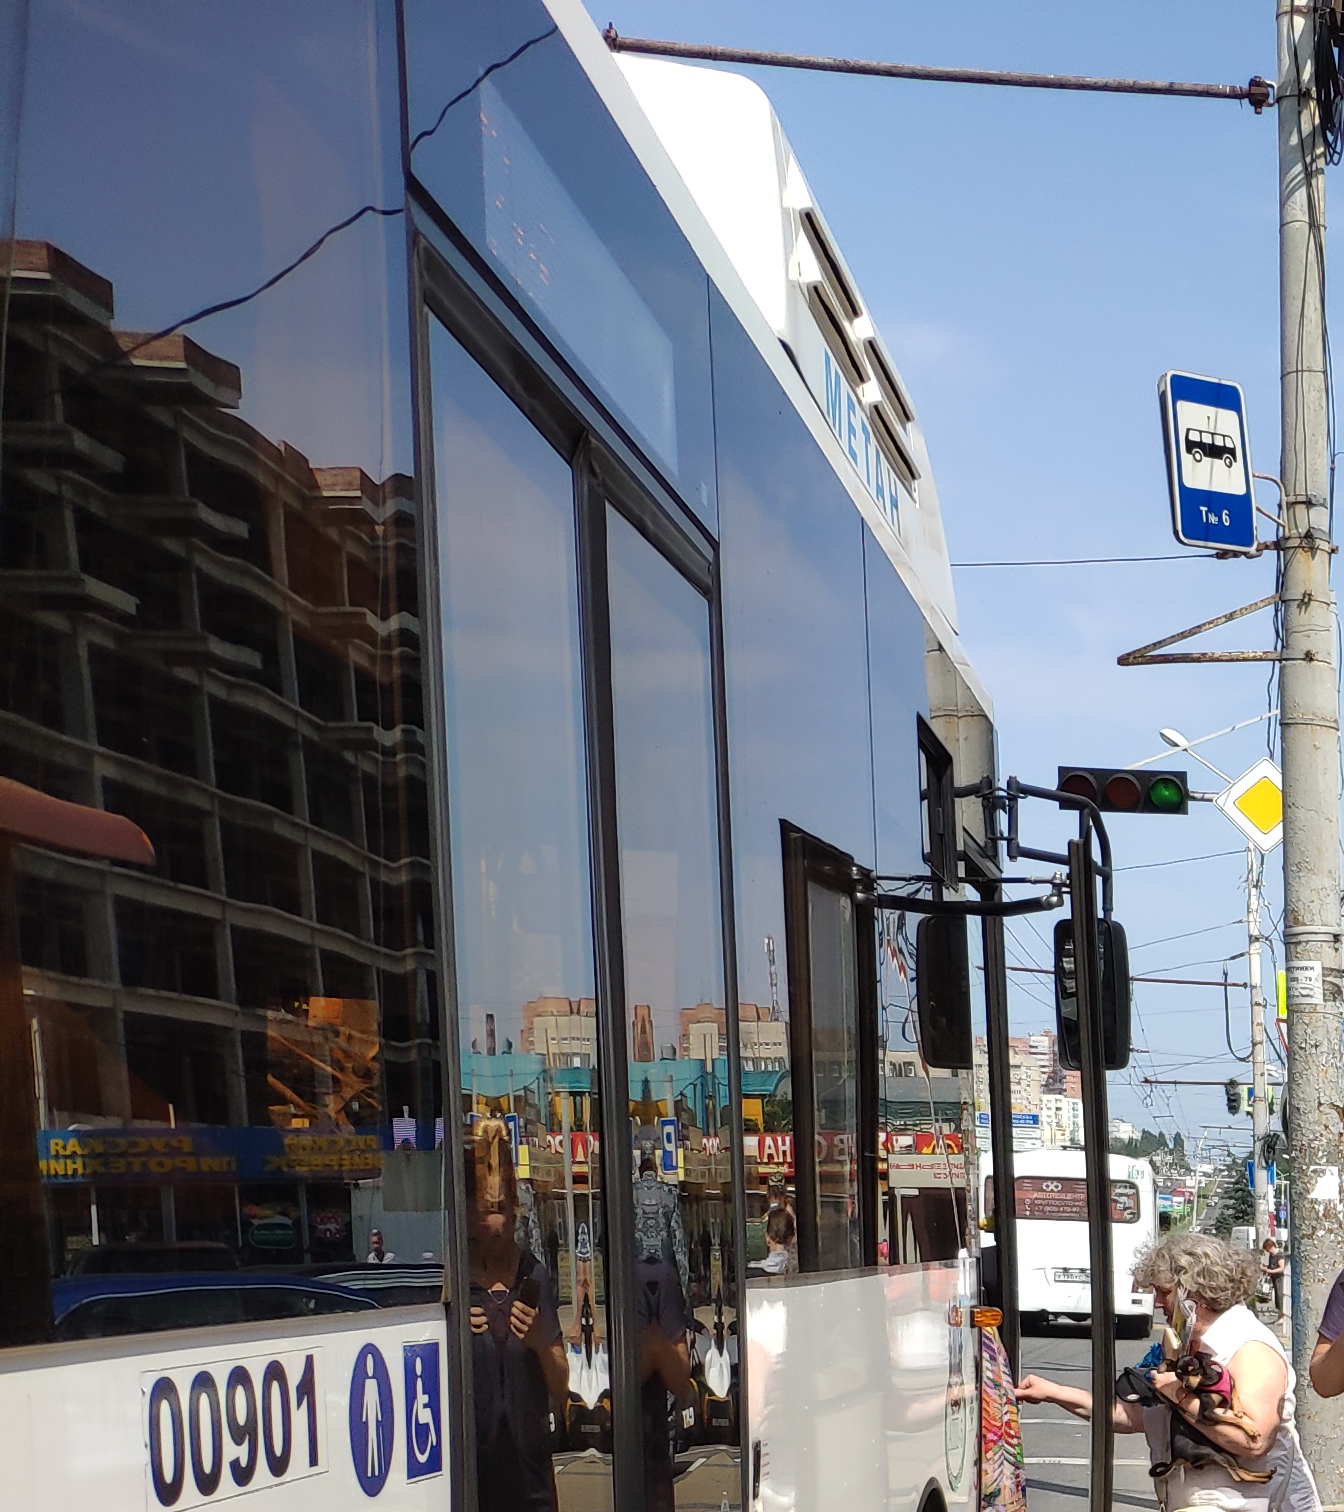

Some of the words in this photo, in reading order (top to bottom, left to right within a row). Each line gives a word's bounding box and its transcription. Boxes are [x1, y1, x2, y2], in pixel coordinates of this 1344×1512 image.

[824, 347, 902, 538] МЕТАН
[1222, 509, 1231, 527] 6
[149, 1353, 319, 1508] 00901
